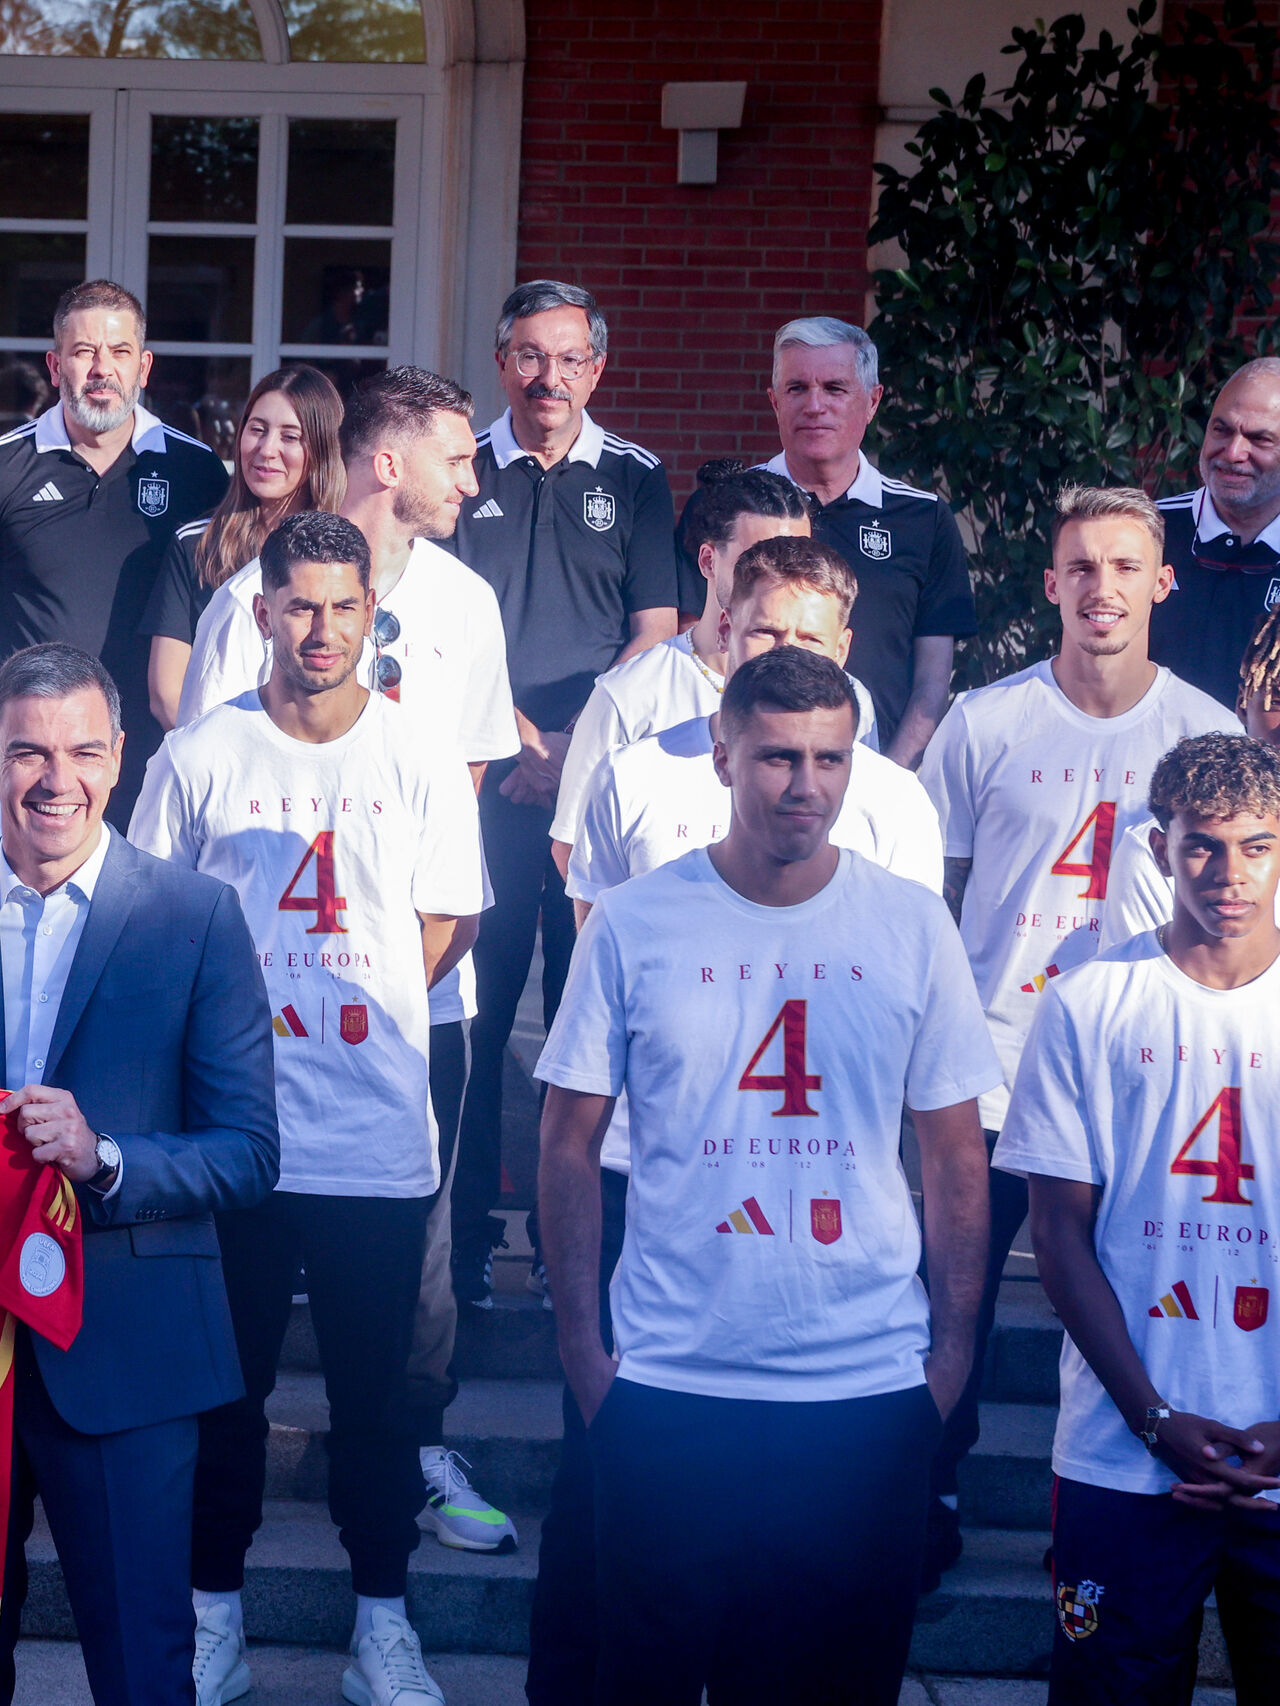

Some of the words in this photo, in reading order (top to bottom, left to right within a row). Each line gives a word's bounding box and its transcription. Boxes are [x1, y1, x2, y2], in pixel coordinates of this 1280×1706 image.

[1031, 768, 1136, 785] REYE
[250, 797, 383, 814] REYES
[1050, 801, 1117, 901] 4
[278, 830, 349, 934] 4
[1015, 912, 1042, 928] DE
[1056, 915, 1100, 932] EUR
[287, 952, 371, 967] EUROPA
[700, 963, 863, 983] REYES
[738, 999, 823, 1117] 4
[1139, 1044, 1263, 1069] REYE
[703, 1138, 735, 1155] DE
[749, 1138, 856, 1157] EUROPA
[1170, 1086, 1256, 1207] 4
[1143, 1220, 1164, 1239] DE
